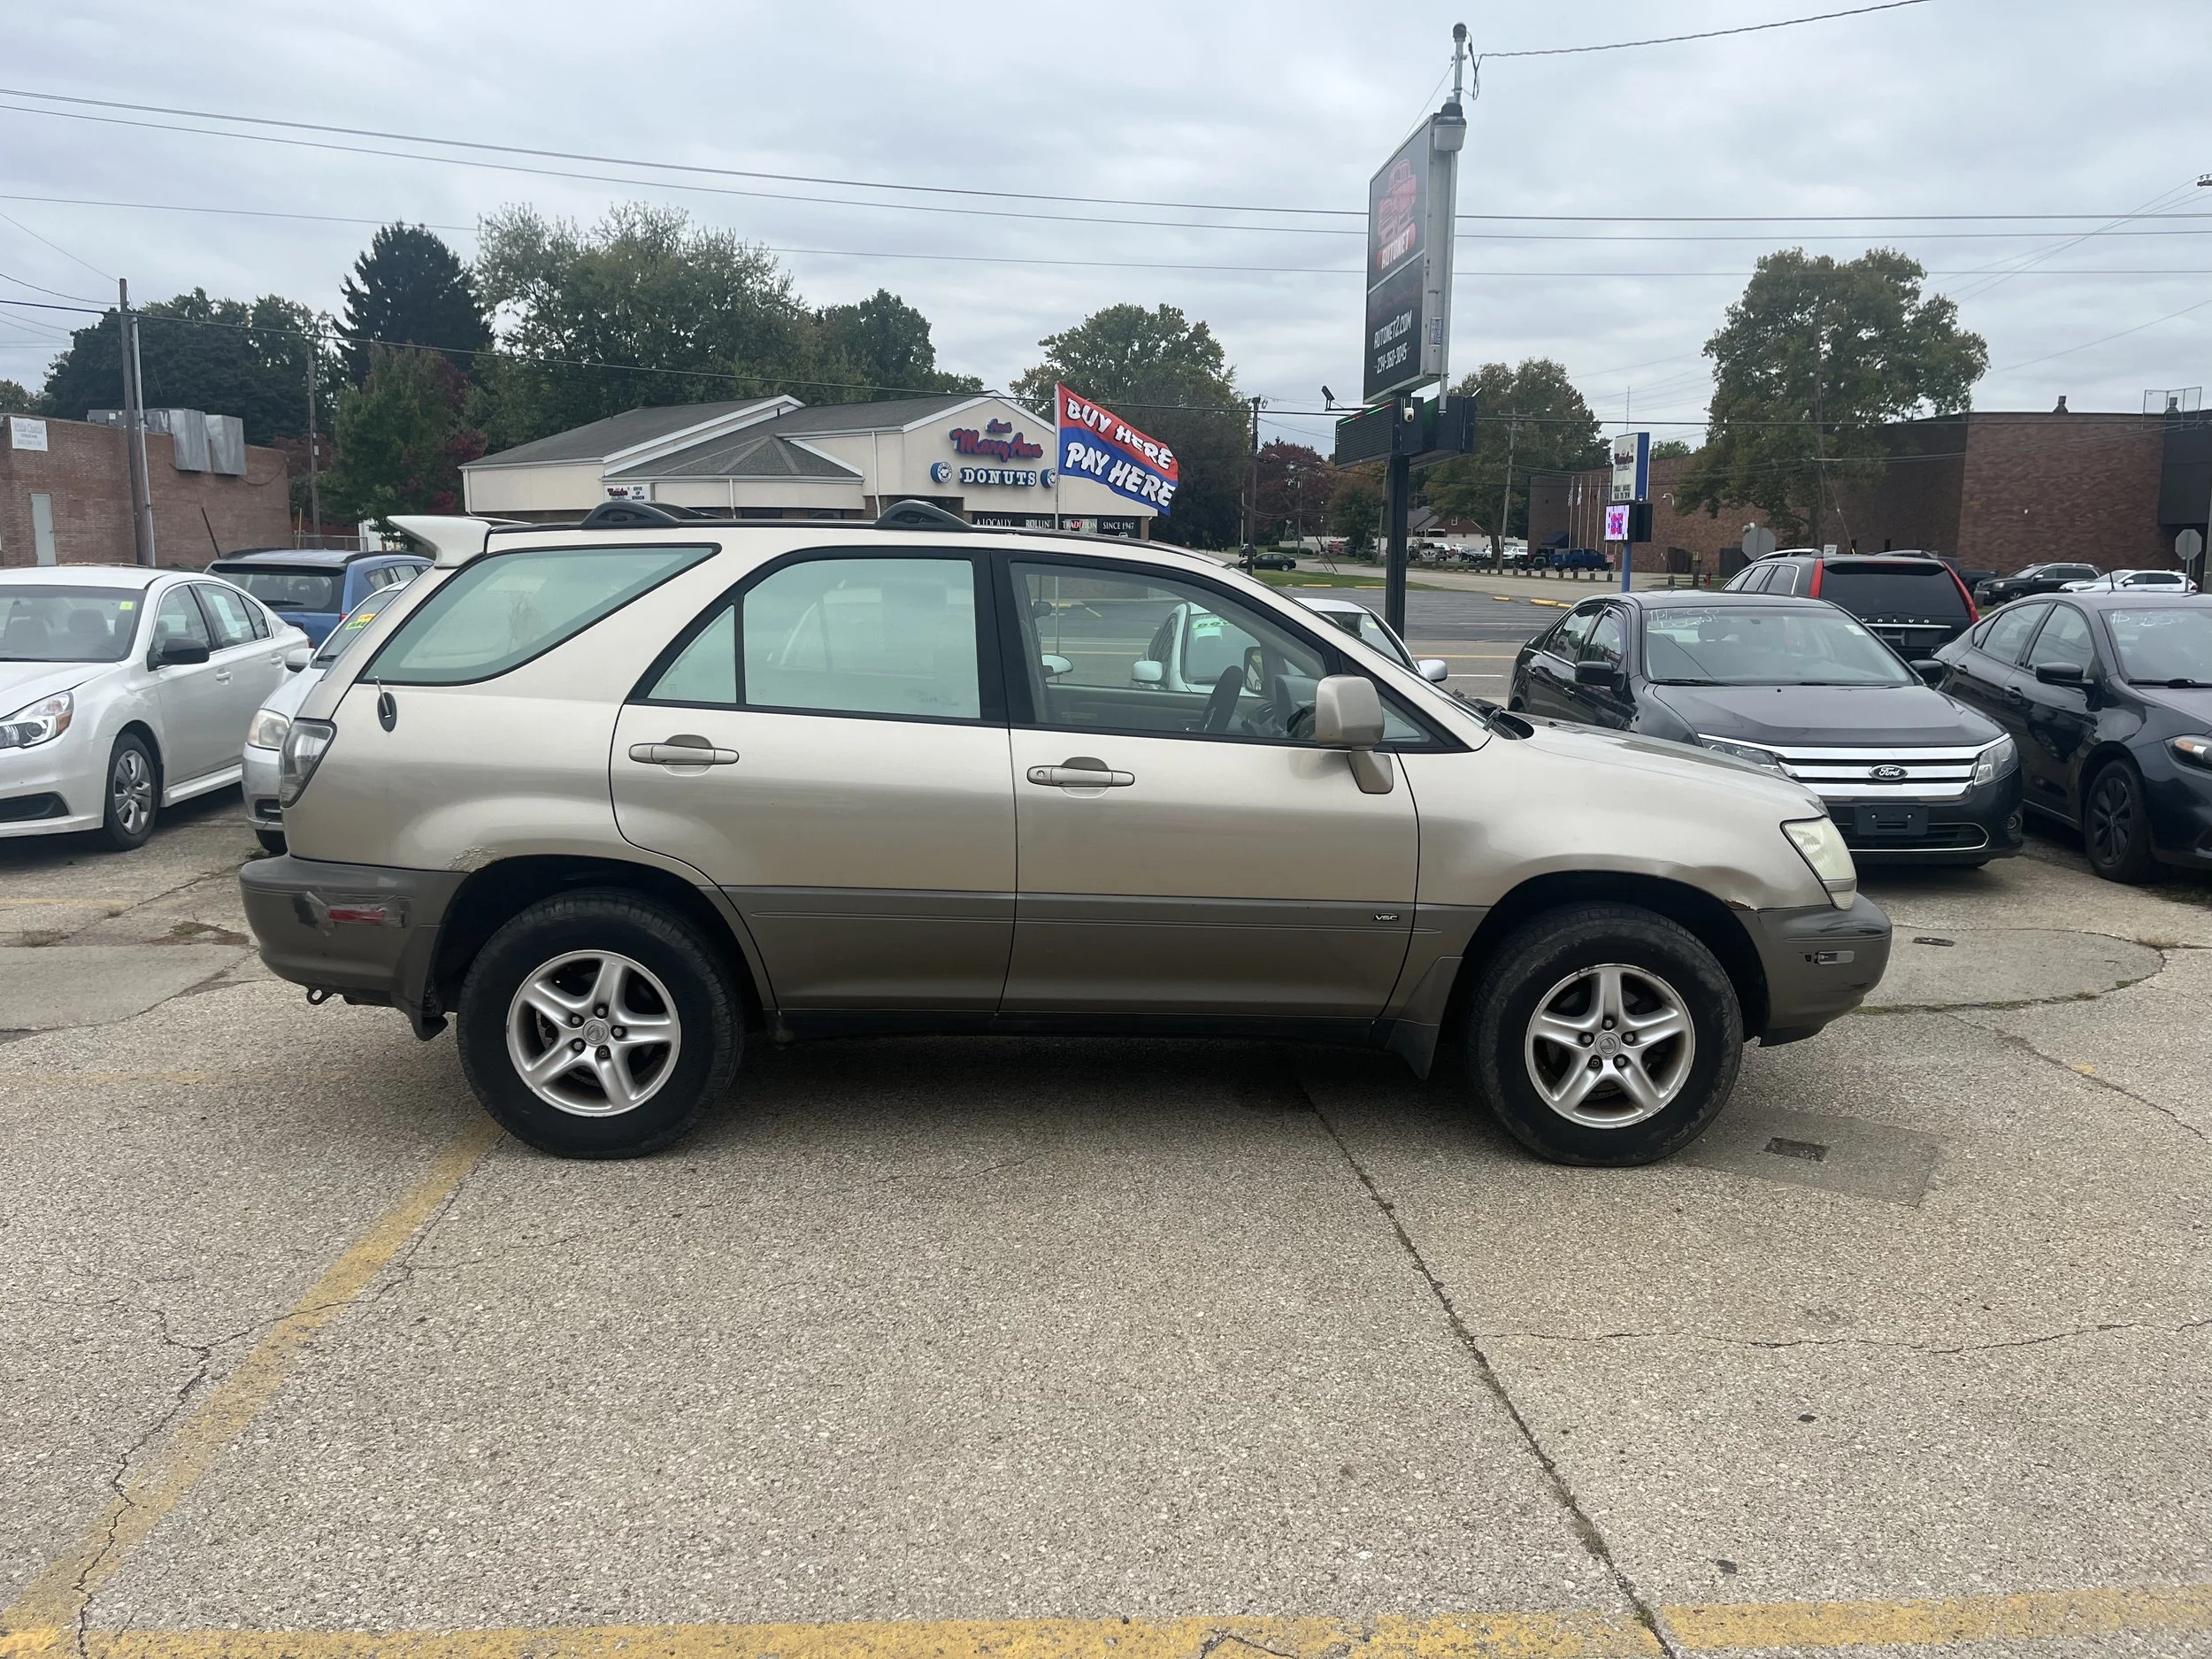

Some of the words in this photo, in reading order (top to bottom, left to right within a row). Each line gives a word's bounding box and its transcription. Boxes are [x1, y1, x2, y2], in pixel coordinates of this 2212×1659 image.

[1381, 228, 1410, 269] AUTONET
[949, 428, 1009, 463] Mary
[1066, 397, 1112, 434] BUY
[1115, 425, 1173, 470] HERE
[963, 468, 1037, 486] DONUTS
[1065, 442, 1110, 476] PAY
[1107, 459, 1176, 507] HERE
